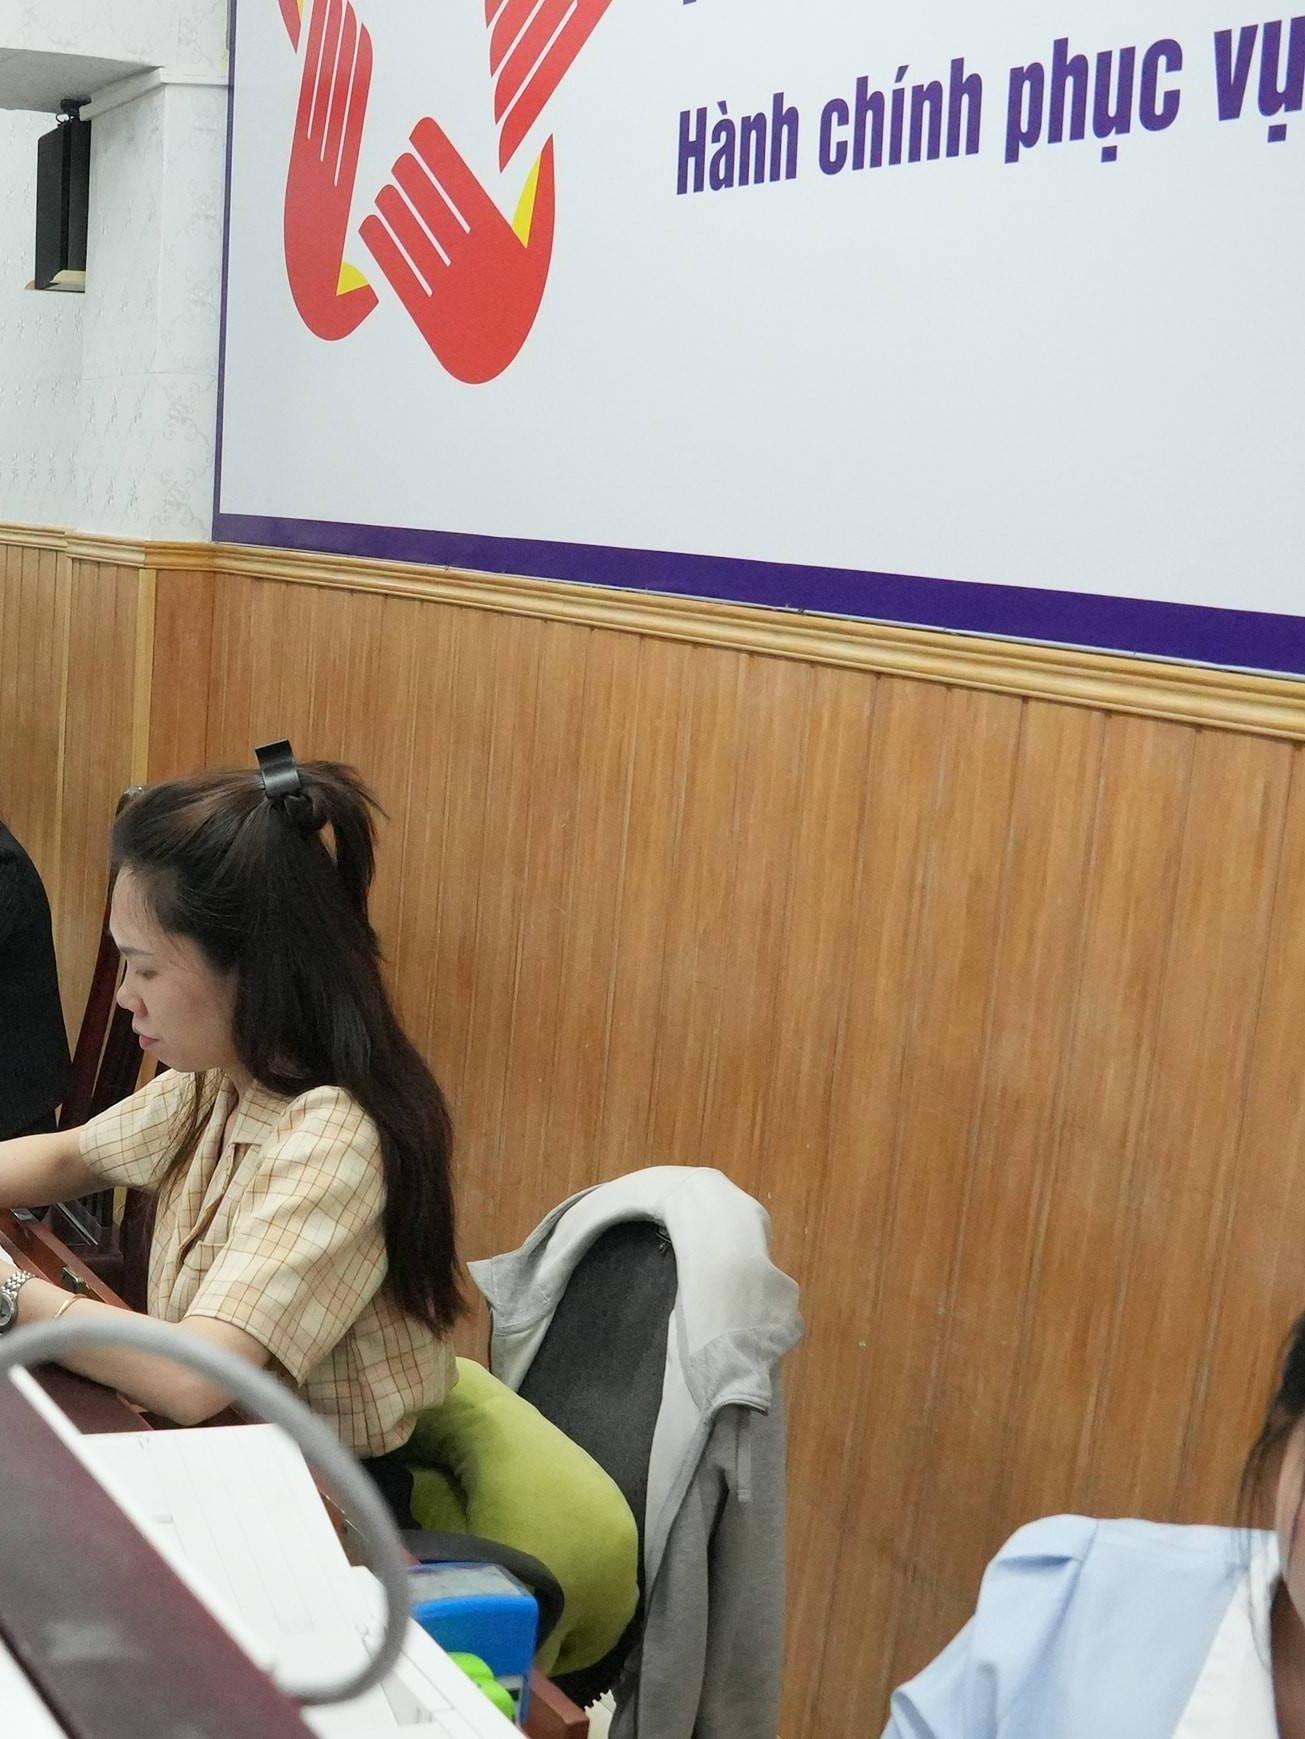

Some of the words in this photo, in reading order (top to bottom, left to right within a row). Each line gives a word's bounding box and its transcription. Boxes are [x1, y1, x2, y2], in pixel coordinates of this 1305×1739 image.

[676, 92, 800, 195] Hành
[818, 57, 983, 176] chính
[1004, 37, 1184, 164] phục
[1213, 15, 1305, 143] vụ
